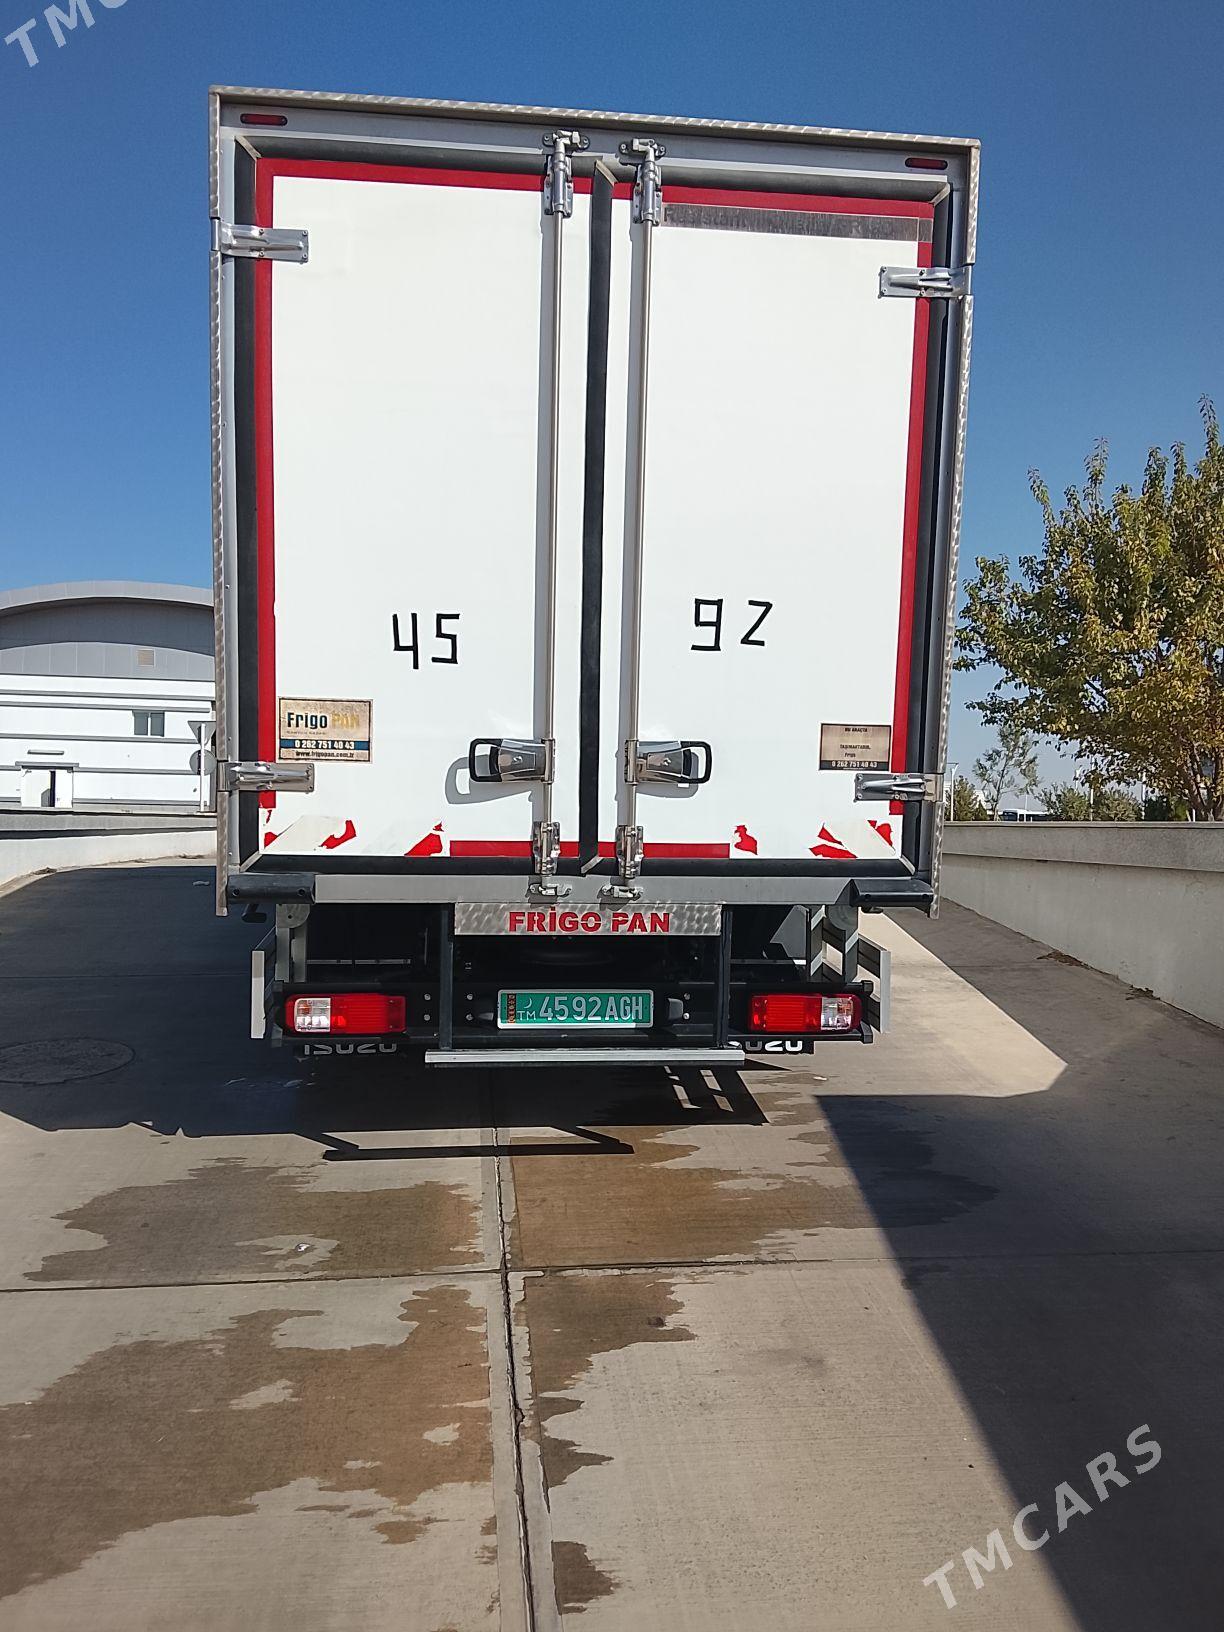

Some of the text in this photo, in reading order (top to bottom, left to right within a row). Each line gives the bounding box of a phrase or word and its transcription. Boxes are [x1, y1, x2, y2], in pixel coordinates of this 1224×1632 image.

[392, 612, 461, 670] 45
[287, 711, 328, 730] Frigo
[294, 739, 355, 751] 0 262 751 40 43
[611, 911, 670, 933] PAN
[517, 996, 643, 1021] TM 4592AGH
